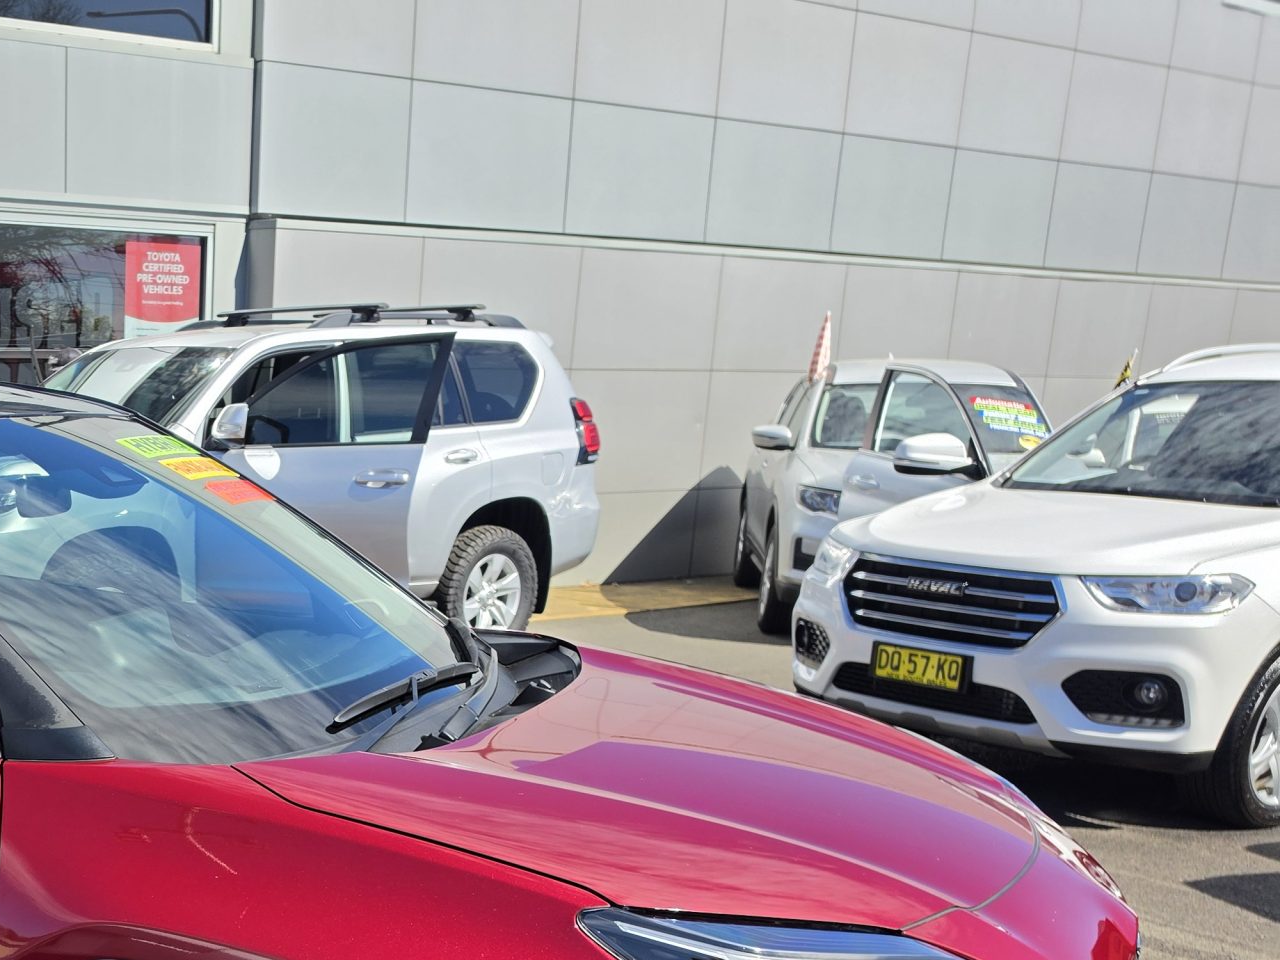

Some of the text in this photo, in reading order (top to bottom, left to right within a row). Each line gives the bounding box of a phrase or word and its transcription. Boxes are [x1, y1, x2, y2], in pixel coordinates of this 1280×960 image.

[146, 251, 181, 262] TOYOTA
[142, 262, 184, 273] CERTIFIED
[136, 273, 190, 284] PRE-OWNED
[142, 284, 184, 294] VEHICLES
[907, 577, 962, 595] HAVAL
